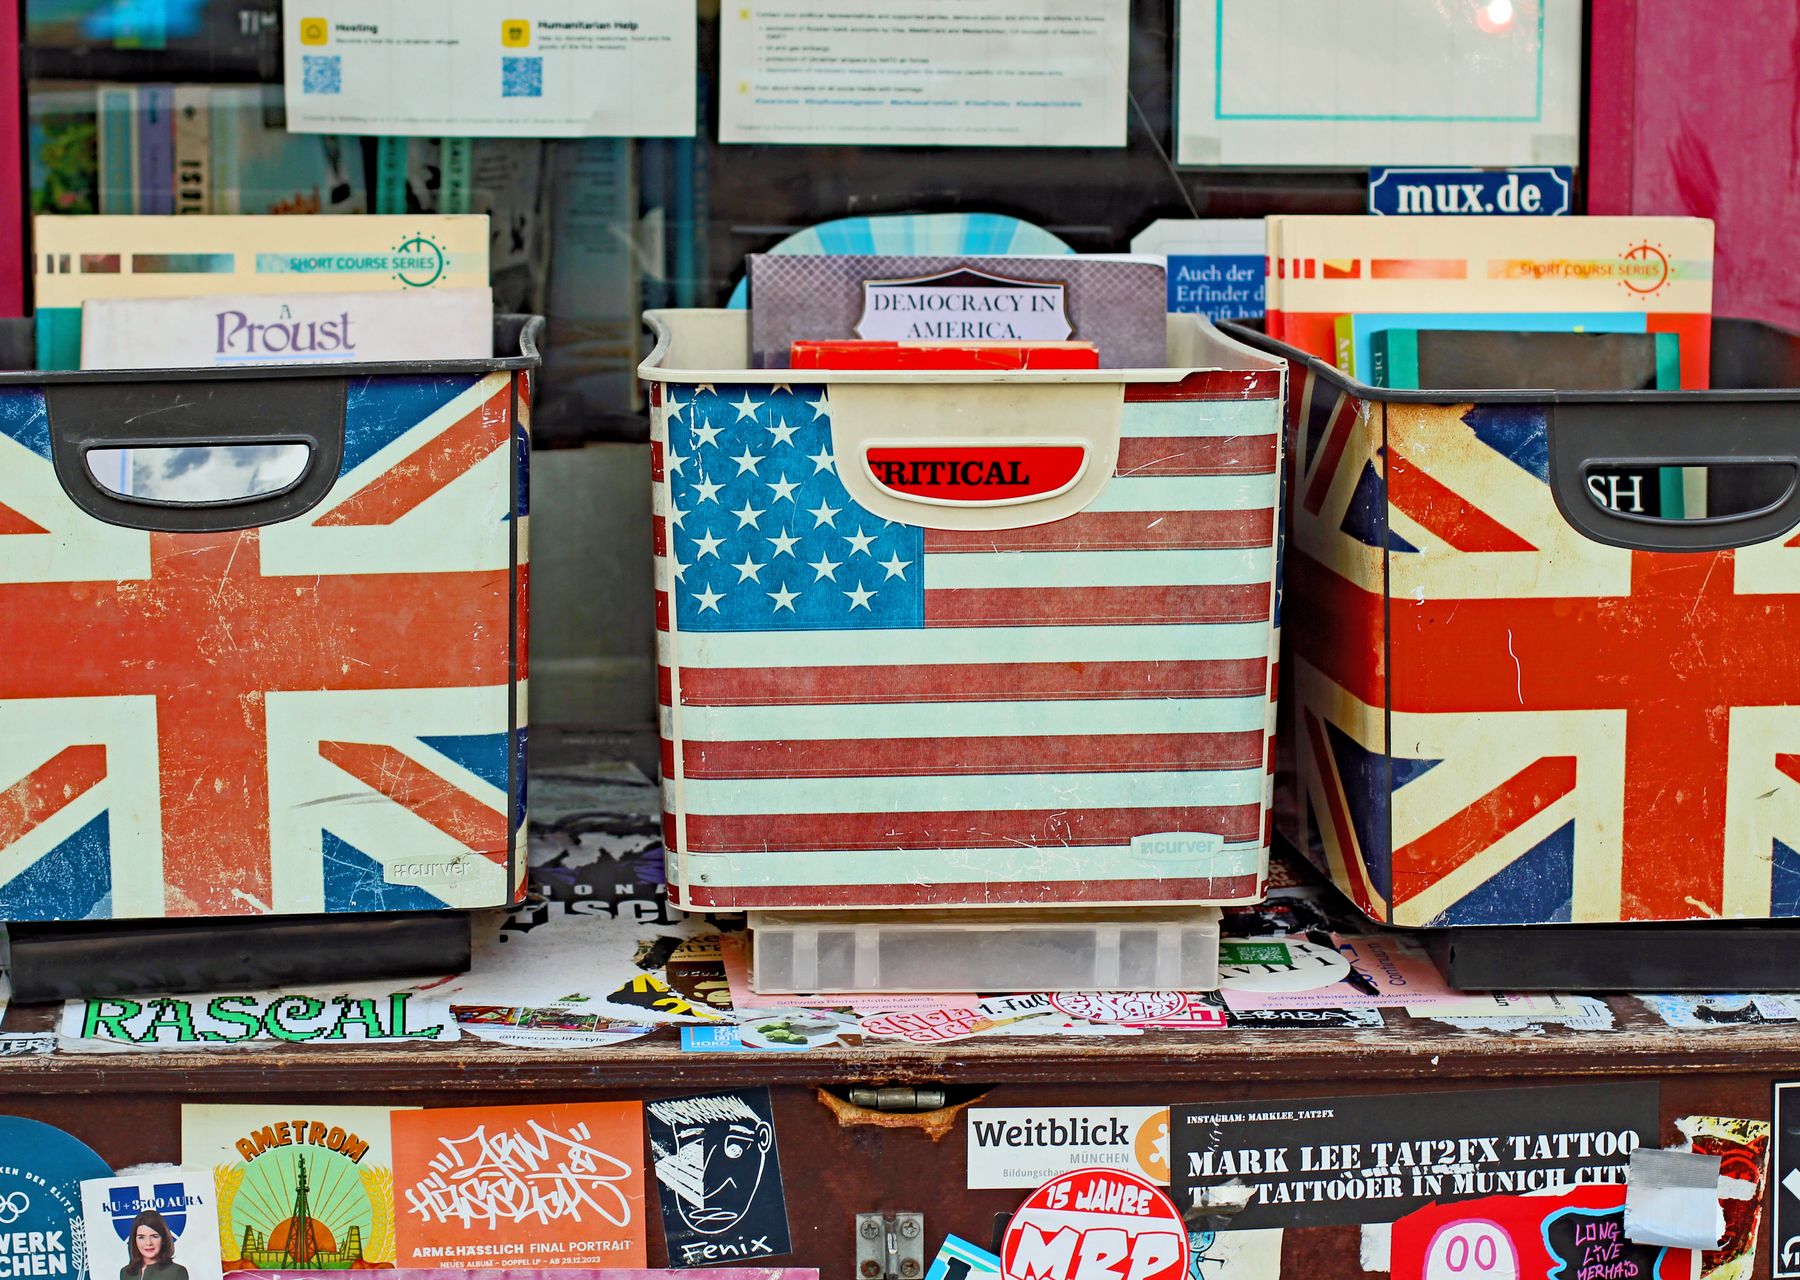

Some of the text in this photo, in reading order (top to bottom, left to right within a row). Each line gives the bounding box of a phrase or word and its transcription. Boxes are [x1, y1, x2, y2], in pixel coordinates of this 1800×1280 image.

[538, 21, 612, 30] Humanitarian
[1397, 174, 1542, 213] mux.de
[289, 257, 435, 270] SHORT COURSE SERIES
[1176, 264, 1255, 281] Auch der
[1520, 263, 1660, 276] SHORT COURSE SERIES
[1176, 285, 1250, 302] Erfinder
[279, 304, 292, 319] A
[874, 294, 1056, 312] DEMOCRACY IN
[215, 311, 356, 353] Proust
[907, 322, 1022, 341] AMERICA,
[1154, 839, 1215, 855] curver
[408, 862, 470, 877] curver
[80, 993, 444, 1044] RASCAL
[1186, 1109, 1334, 1124] INSTAGRAM: MARKLEE_TAT2FX
[972, 1117, 1129, 1148] Weitblick
[235, 1120, 369, 1164] AMETROM
[1070, 1152, 1129, 1164] MÜNCHEN
[1187, 1130, 1640, 1177] MARK LEE TAT2FX TATTOO
[1412, 1174, 1443, 1197] IN
[1452, 1168, 1566, 1195] MUNICH
[25, 1172, 46, 1187] DER
[50, 1186, 75, 1214] ELITE
[1046, 1180, 1073, 1209] 15
[1075, 1178, 1153, 1216] JAHRE
[102, 1200, 121, 1213] KU
[132, 1198, 165, 1212] 3500
[166, 1195, 204, 1208] AURA
[1575, 1221, 1621, 1246] LONG
[530, 1242, 566, 1254] FINAL
[569, 1240, 632, 1252] PORTRAIT
[681, 1235, 773, 1262] Fenix
[440, 1261, 465, 1269] NEUES
[467, 1259, 493, 1267] ALBUM
[501, 1258, 531, 1266] DOPPEL
[532, 1258, 541, 1266] LP
[549, 1257, 560, 1265] AB
